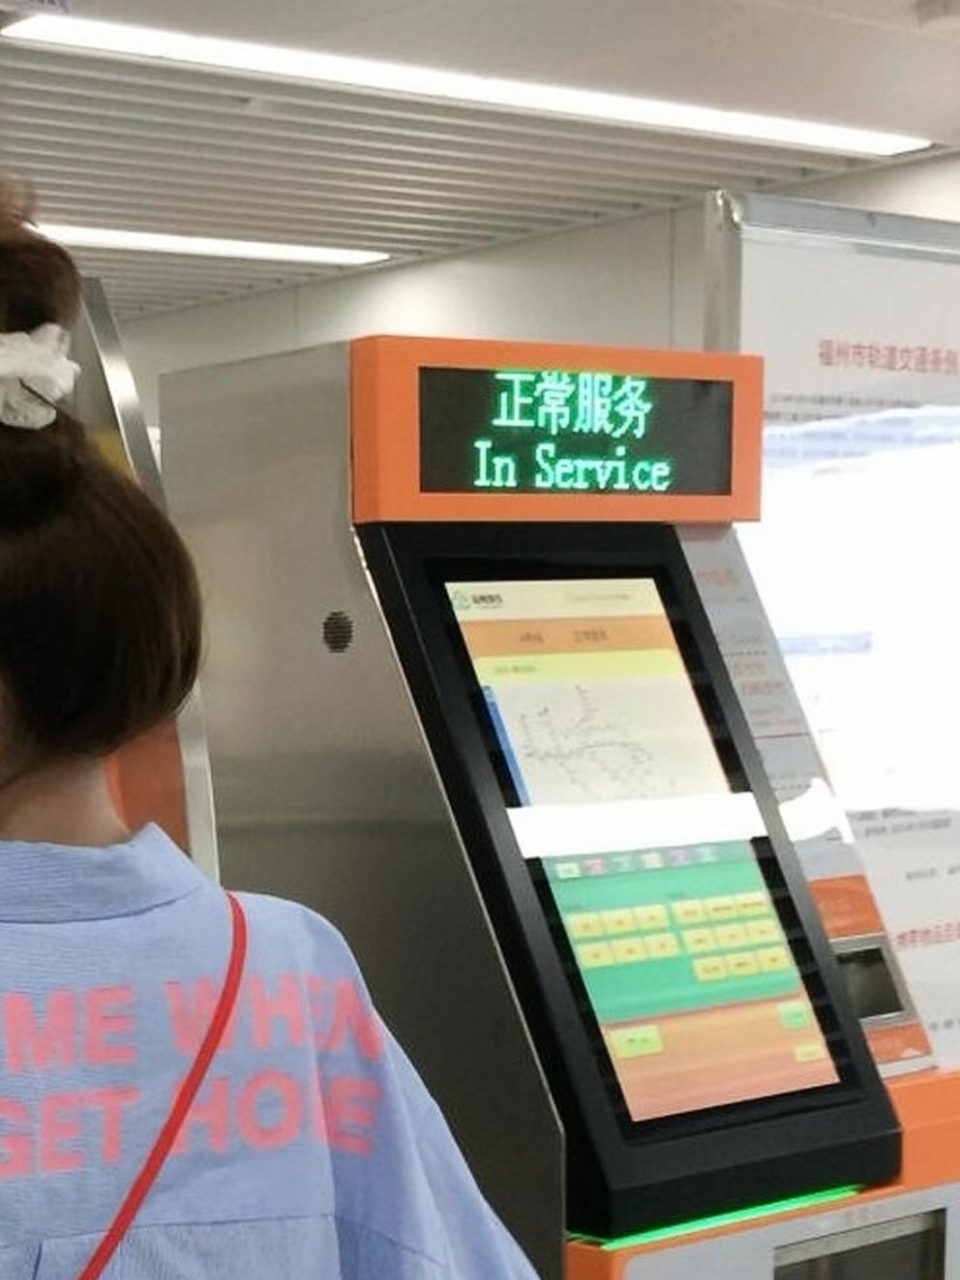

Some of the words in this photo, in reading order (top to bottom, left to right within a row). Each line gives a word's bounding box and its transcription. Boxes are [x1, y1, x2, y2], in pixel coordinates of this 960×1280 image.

[492, 371, 653, 439] 正常服务
[473, 439, 518, 487] In
[534, 442, 672, 491] Service
[0, 983, 137, 1073] ME
[170, 1067, 382, 1157] HOE
